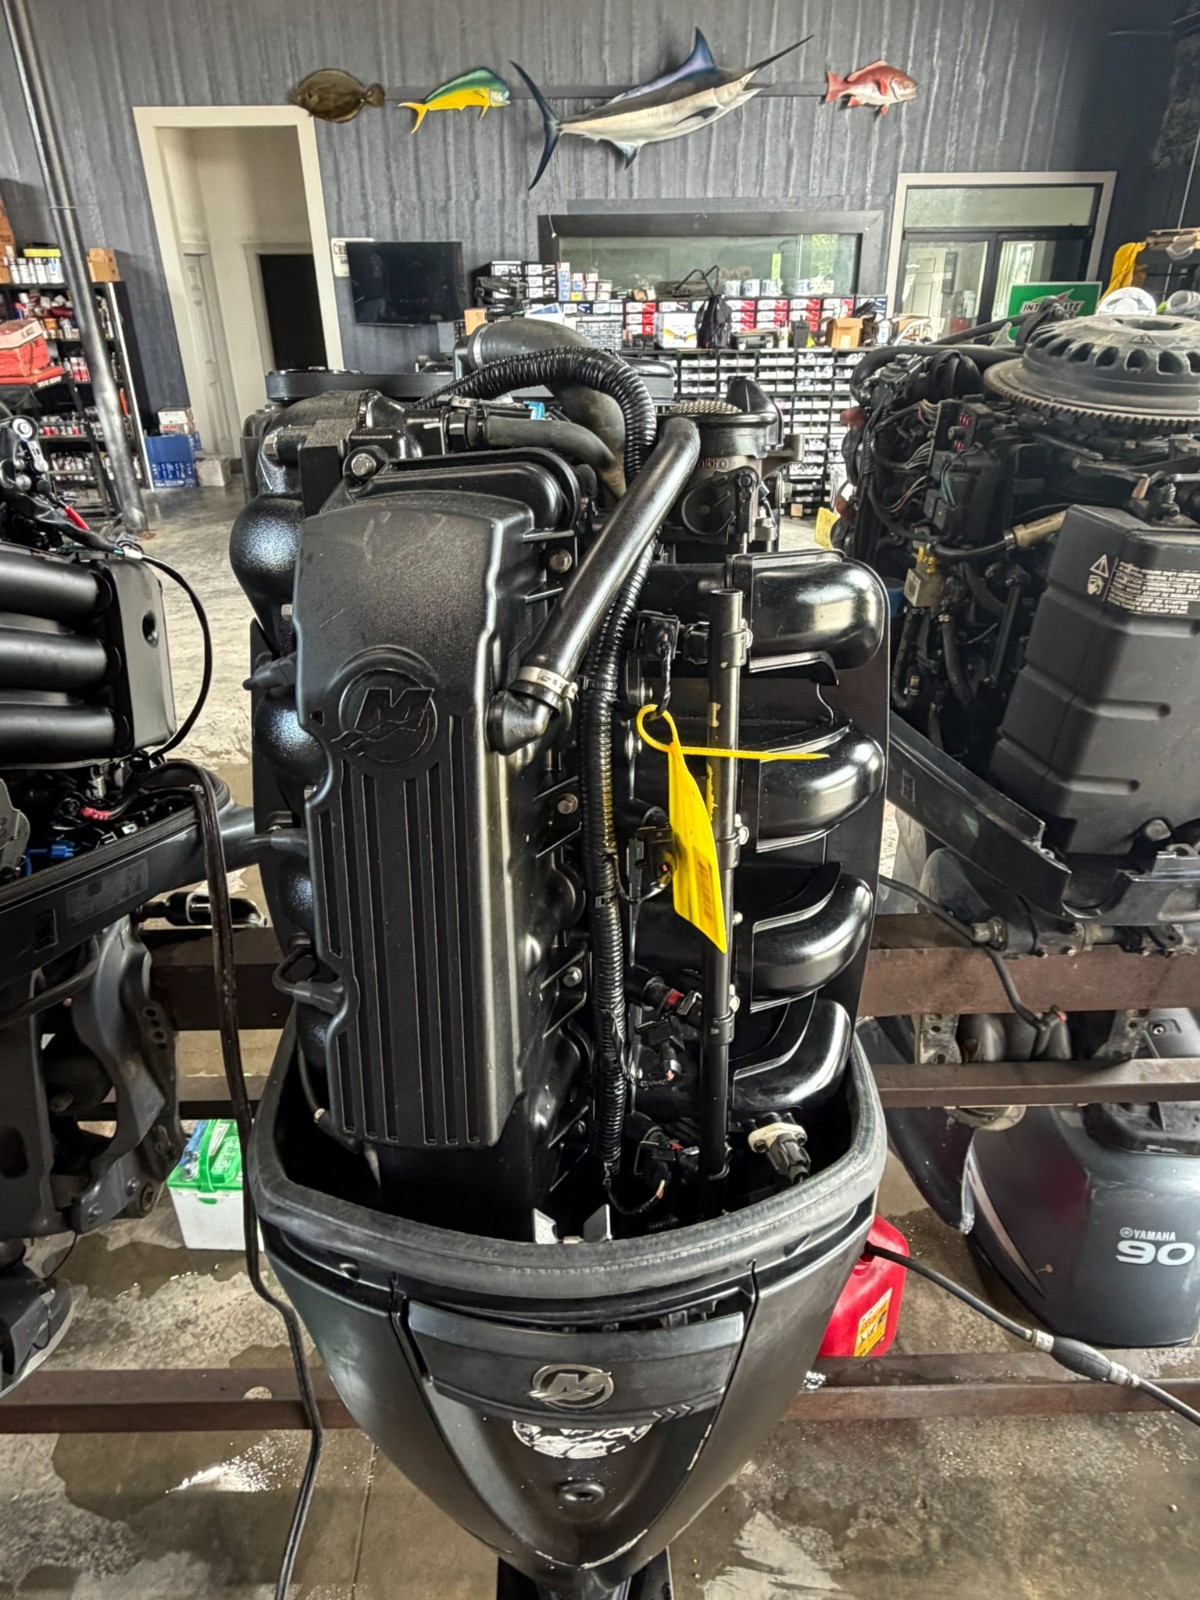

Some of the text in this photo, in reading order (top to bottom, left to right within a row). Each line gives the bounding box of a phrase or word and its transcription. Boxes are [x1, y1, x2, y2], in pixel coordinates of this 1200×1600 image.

[1023, 303, 1080, 312] INTATE
[1133, 1229, 1176, 1241] YAMAHA
[1115, 1240, 1196, 1266] 90
